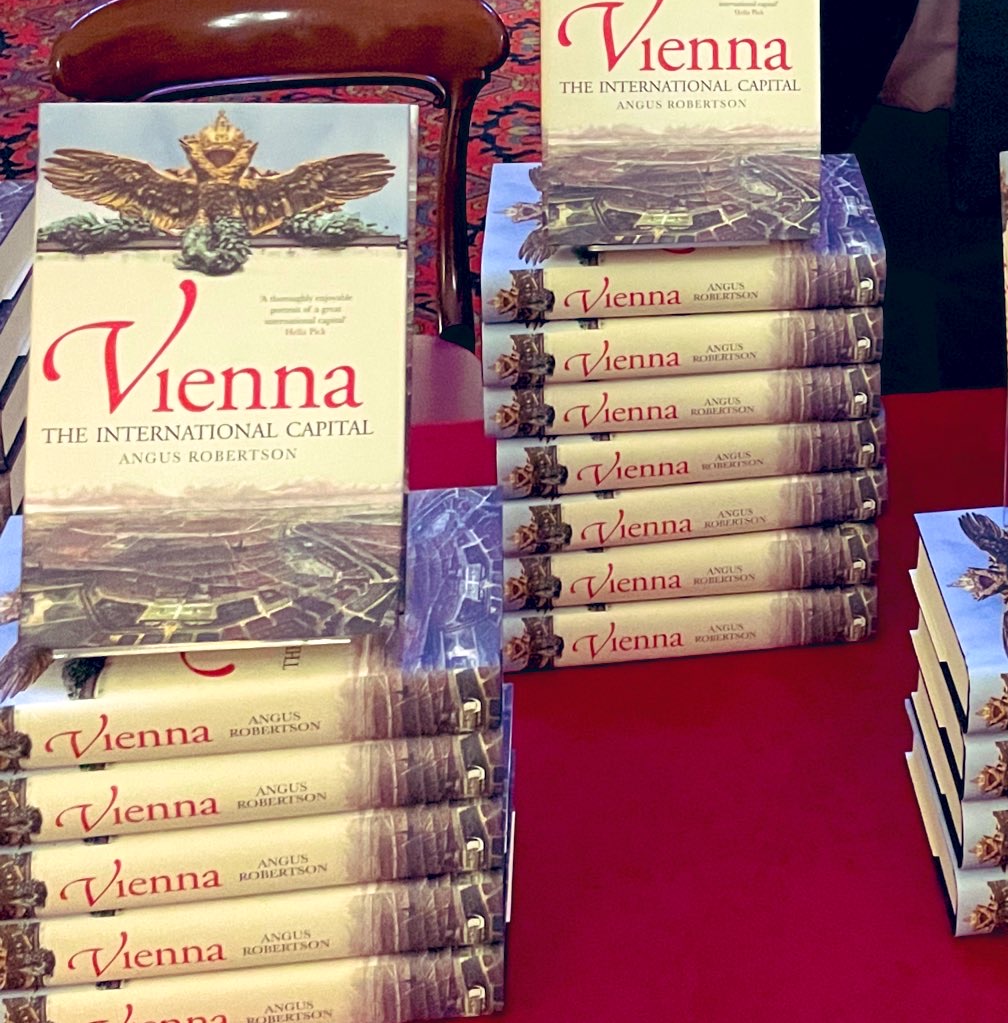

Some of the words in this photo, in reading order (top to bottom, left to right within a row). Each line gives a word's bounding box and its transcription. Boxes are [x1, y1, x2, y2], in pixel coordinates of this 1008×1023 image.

[560, 81, 593, 94] THE
[600, 80, 732, 93] INTERNATIONAL
[738, 79, 801, 92] CAPITAL
[616, 100, 662, 110] ANGUS
[668, 99, 747, 109] ROBERTSON
[707, 282, 745, 292] ANGUS
[564, 276, 682, 314] Vienna
[693, 290, 759, 301] ROBERTSON
[42, 279, 363, 415] Vienna
[706, 343, 744, 353] ANGUS
[564, 340, 680, 377] Vienna
[693, 351, 757, 363] ROBERTSON
[704, 397, 741, 407] ANGUS
[564, 392, 679, 428] Vienna
[690, 404, 756, 416] ROBERTSON
[42, 428, 88, 445] THE
[97, 423, 279, 443] INTERNATIONAL
[286, 419, 374, 438] CAPITAL
[118, 451, 181, 465] ANGUS
[188, 448, 298, 463] ROBERTSON
[714, 451, 752, 462] ANGUS
[576, 451, 689, 487] Vienna
[701, 458, 765, 471] ROBERTSON
[718, 508, 754, 519] ANGUS
[580, 509, 692, 544] Vienna
[704, 515, 767, 529] ROBERTSON
[707, 565, 743, 576] ANGUS
[570, 563, 682, 599] Vienna
[693, 573, 756, 586] ROBERTSON
[708, 623, 744, 634] ANGUS
[572, 622, 684, 659] Vienna
[694, 630, 757, 643] ROBERTSON
[248, 711, 301, 725] ANGUS
[44, 714, 213, 759] Vienna
[229, 720, 321, 738] ROBERTSON
[255, 782, 308, 797] ANGUS
[237, 791, 328, 810] ROBERTSON
[55, 785, 221, 833] Vienna
[258, 854, 310, 869] ANGUS
[238, 862, 328, 883] ROBERTSON
[59, 858, 223, 908] Vienna
[260, 929, 312, 944] ANGUS
[67, 932, 227, 978] Vienna
[242, 938, 331, 957] ROBERTSON
[264, 1000, 314, 1015] ANGUS
